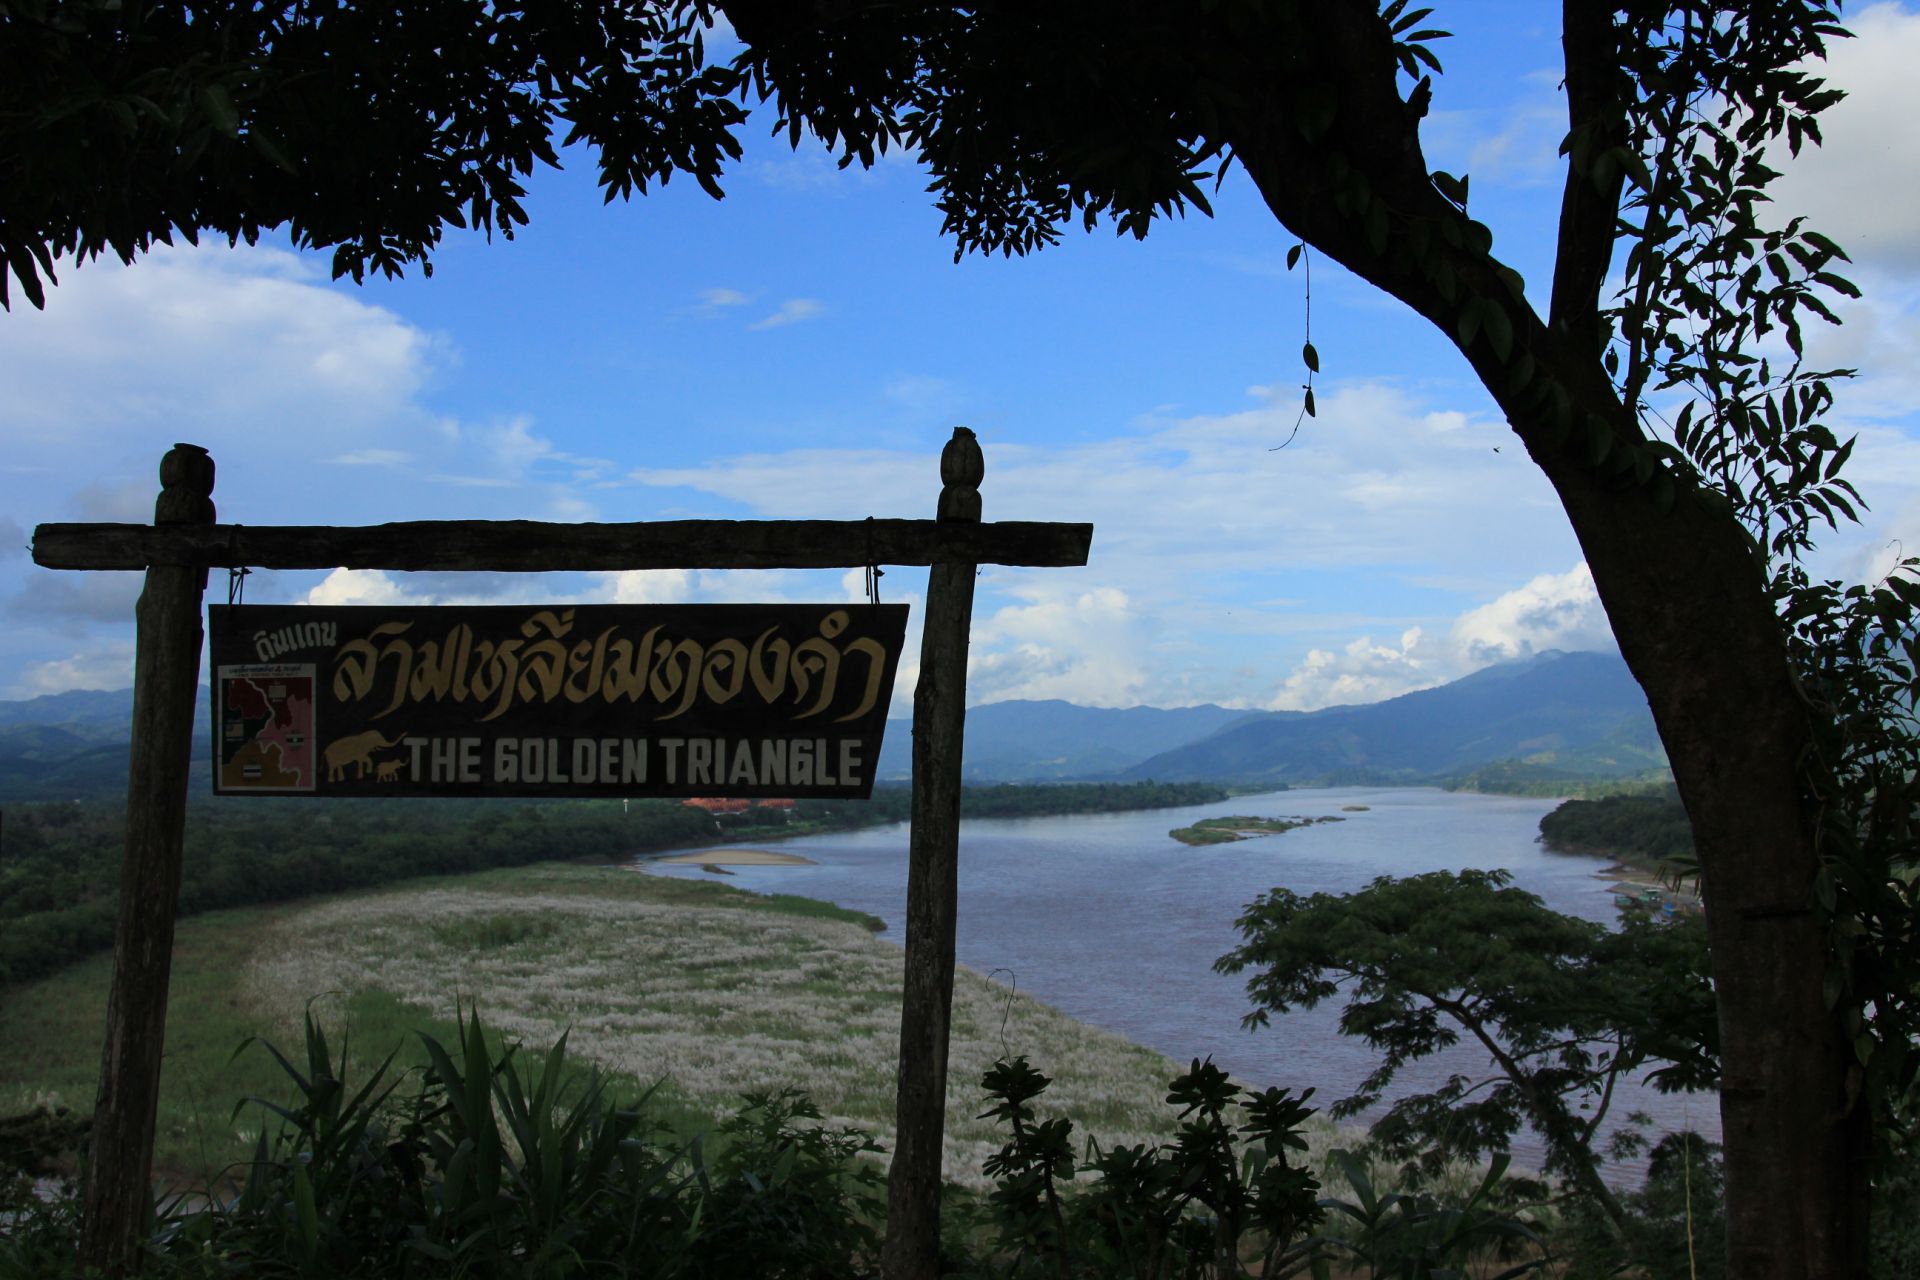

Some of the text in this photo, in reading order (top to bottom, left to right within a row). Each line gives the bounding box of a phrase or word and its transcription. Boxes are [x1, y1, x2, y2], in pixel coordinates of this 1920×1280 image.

[253, 621, 336, 662] ดินแดน
[333, 608, 886, 722] สามเหลี่ยมทองคำ
[403, 737, 862, 786] THE GOLDEN TRIANGLE
